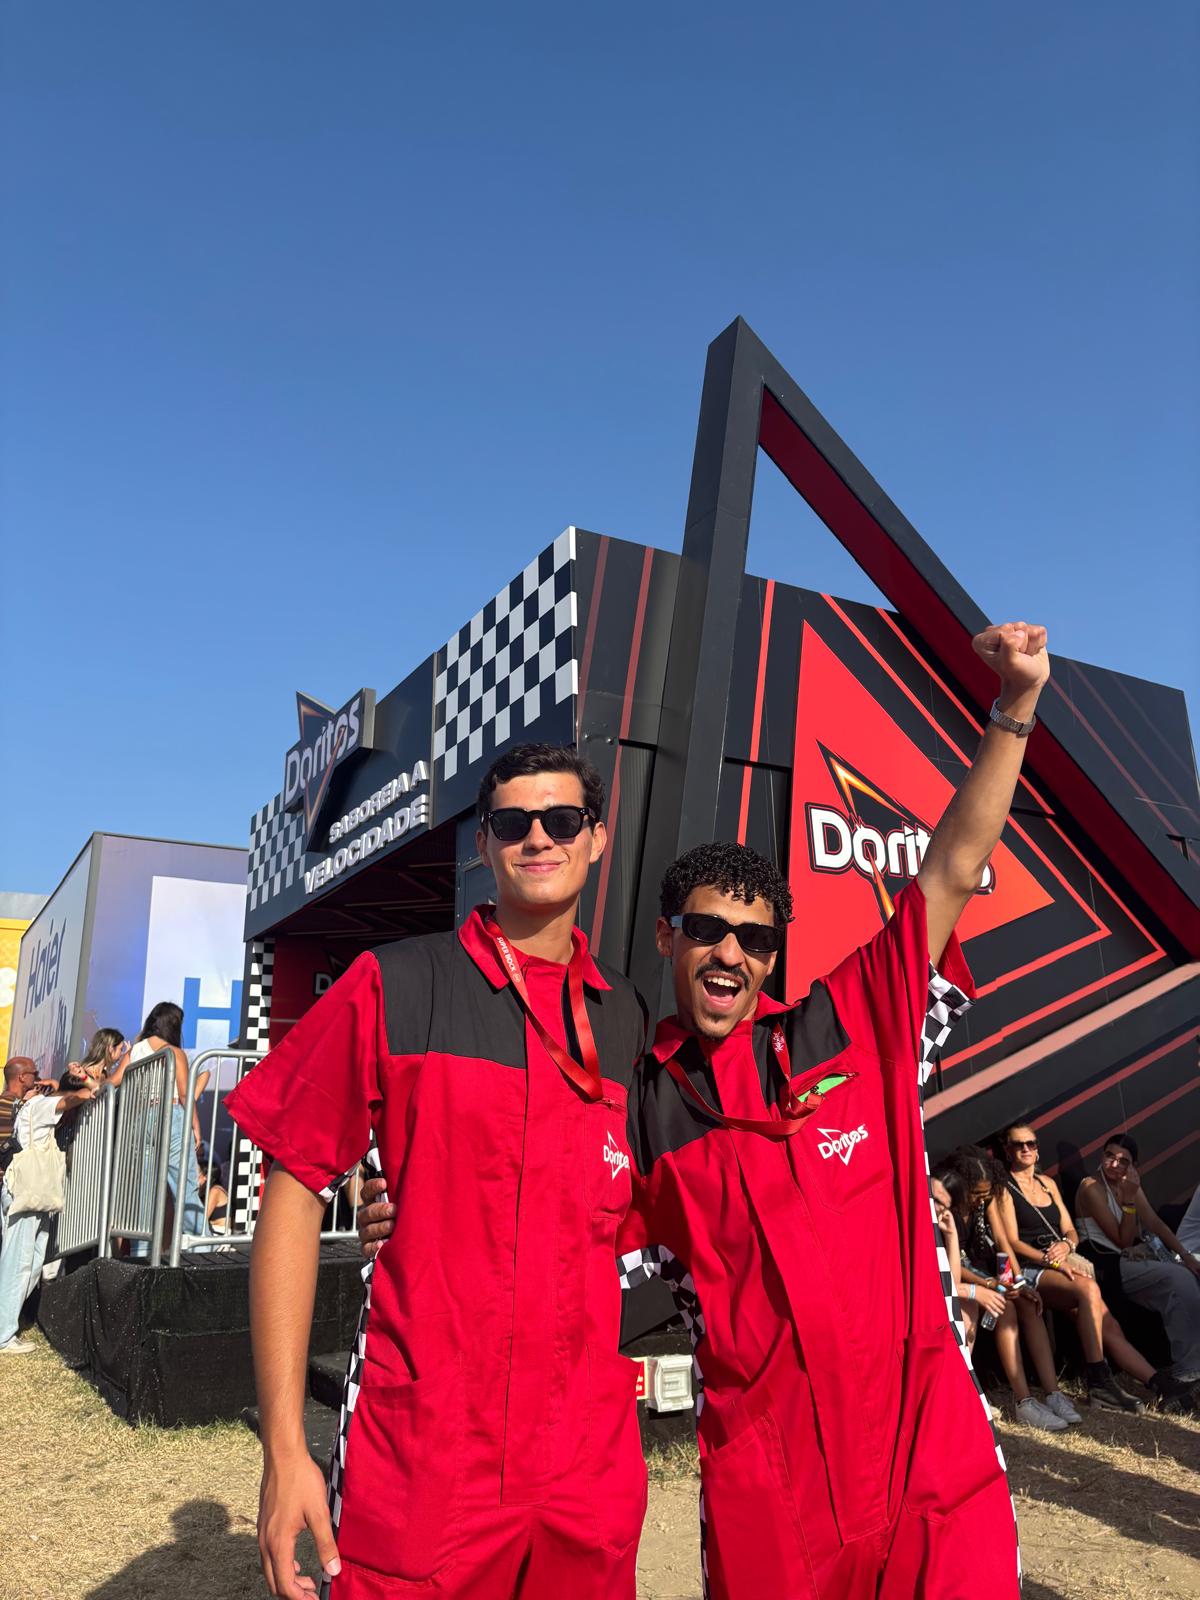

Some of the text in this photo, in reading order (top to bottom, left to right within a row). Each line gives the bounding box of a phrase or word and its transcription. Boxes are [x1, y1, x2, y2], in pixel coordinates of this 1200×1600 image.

[285, 697, 360, 804] Doritos
[304, 794, 429, 894] VELOCIDADE
[329, 760, 429, 844] SABOREIA A
[24, 917, 67, 1019] Haier
[817, 1124, 869, 1160] Doritos
